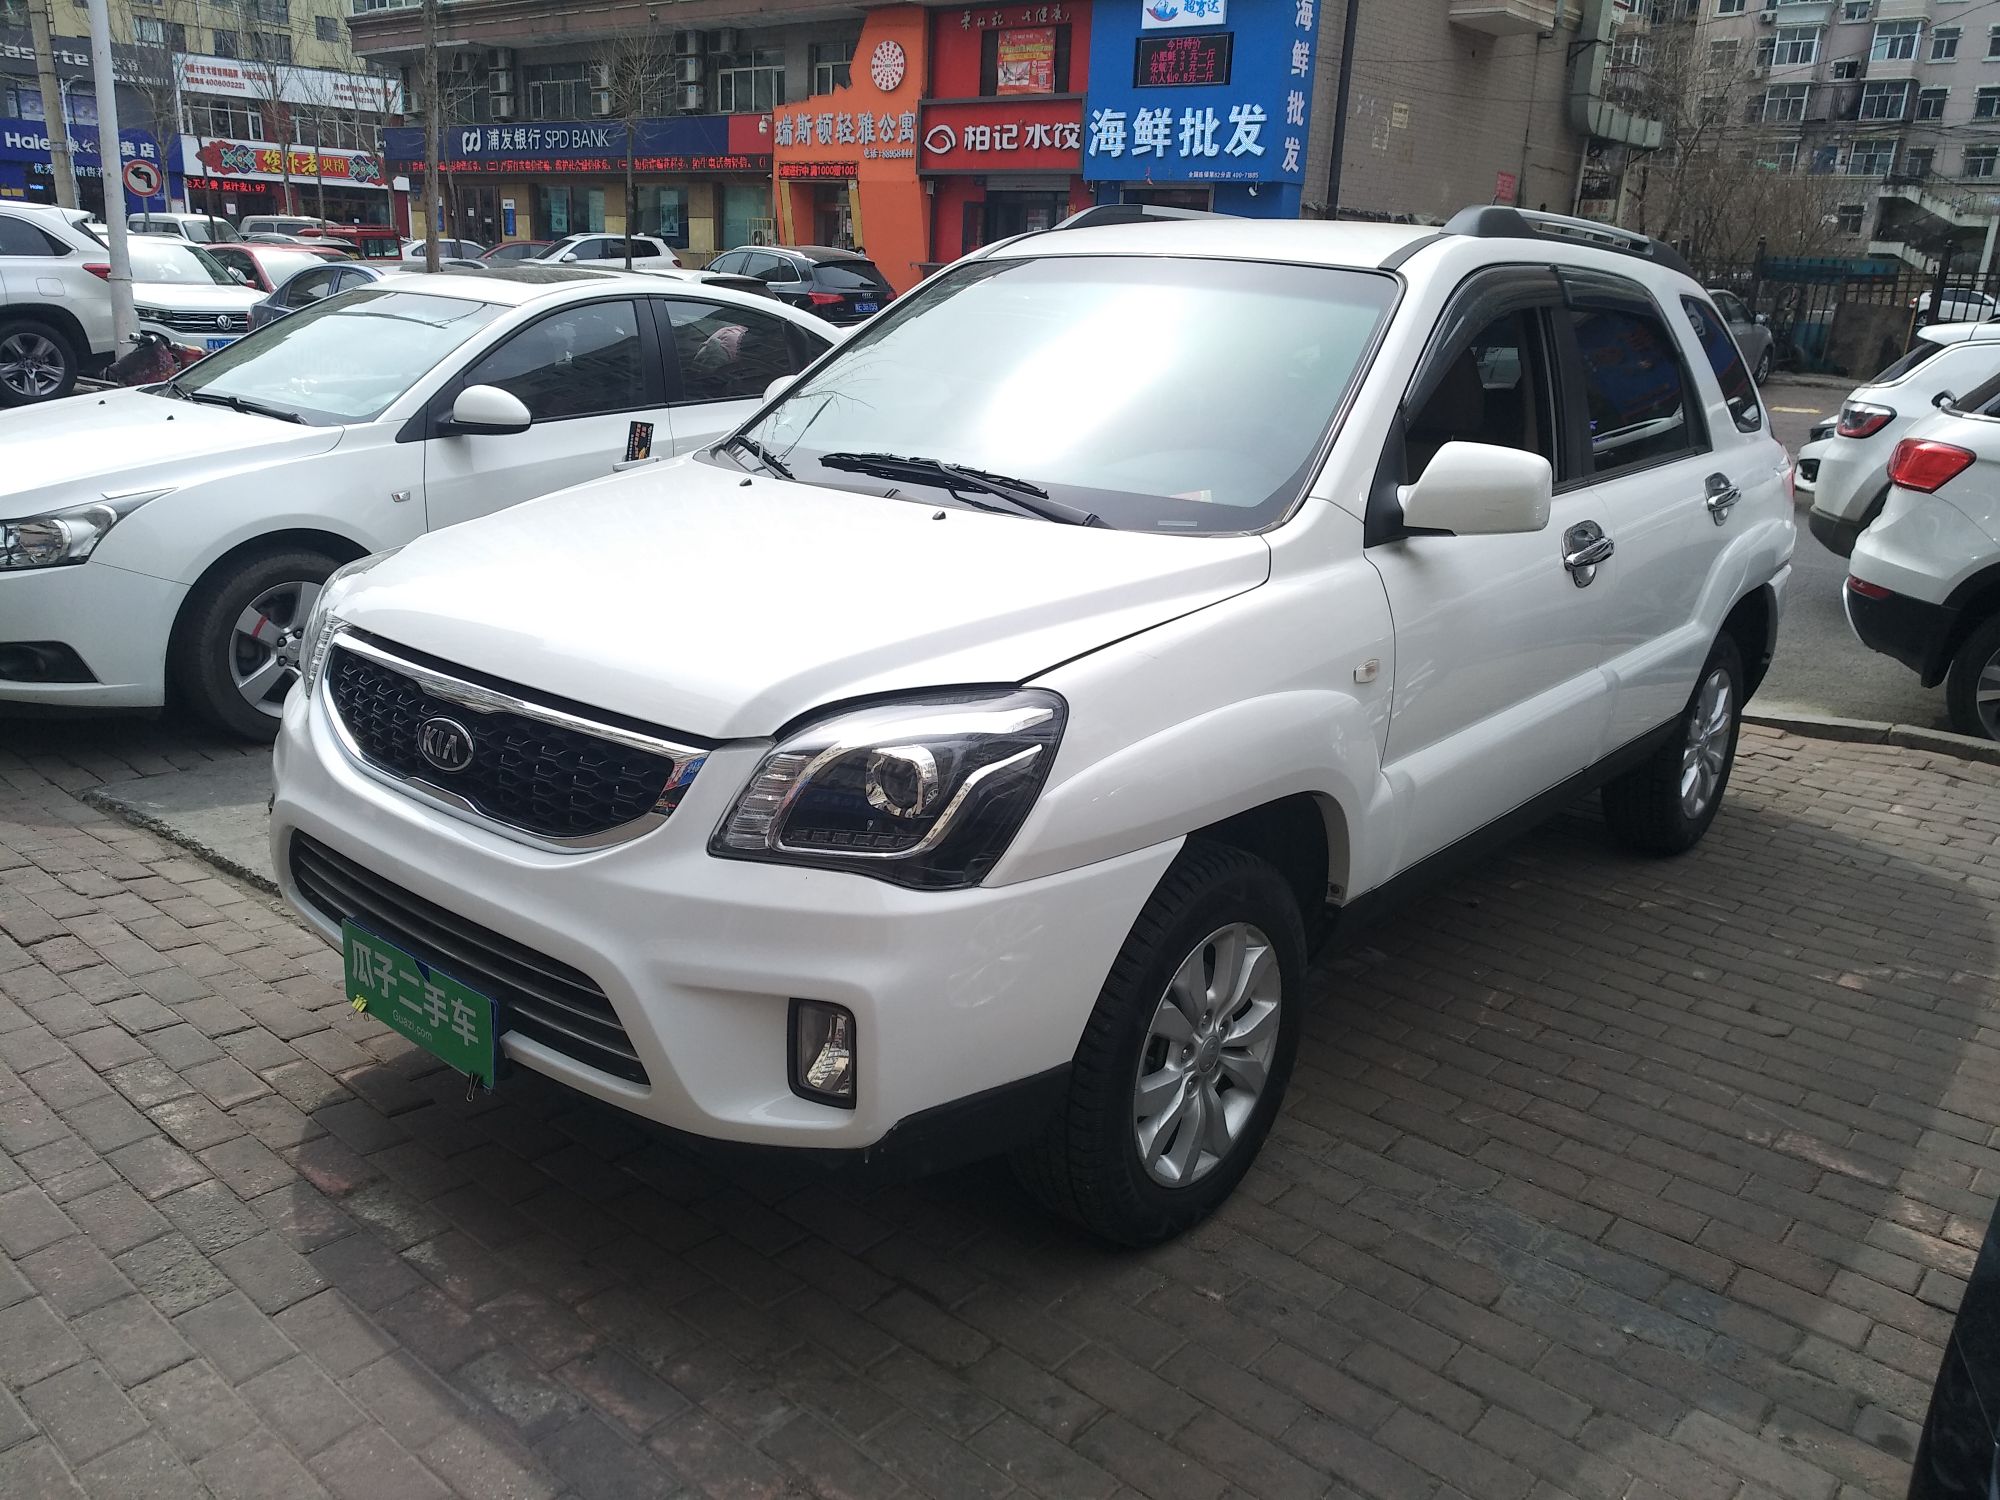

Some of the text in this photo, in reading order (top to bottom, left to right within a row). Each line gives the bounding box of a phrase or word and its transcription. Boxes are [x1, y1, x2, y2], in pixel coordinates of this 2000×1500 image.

[1168, 38, 1201, 50] 今日特价
[1180, 51, 1186, 60] 3
[1190, 49, 1216, 61] 元一斤
[1180, 62, 1185, 72] 3
[1189, 60, 1215, 71] 元一斤
[1282, 0, 1314, 173] 海鲜批发
[487, 128, 609, 151] 浦发银行 SPD BANK
[774, 110, 917, 146] 瑞斯顿轻雅公寓
[963, 122, 1081, 151] 柏记水饺
[1088, 103, 1268, 158] 海鲜批发
[5, 132, 51, 150] Haie
[121, 140, 155, 158] 卖店
[423, 725, 459, 764] KIA
[351, 938, 479, 1047] 瓜子二手车
[392, 1009, 433, 1042] Guazi.com
